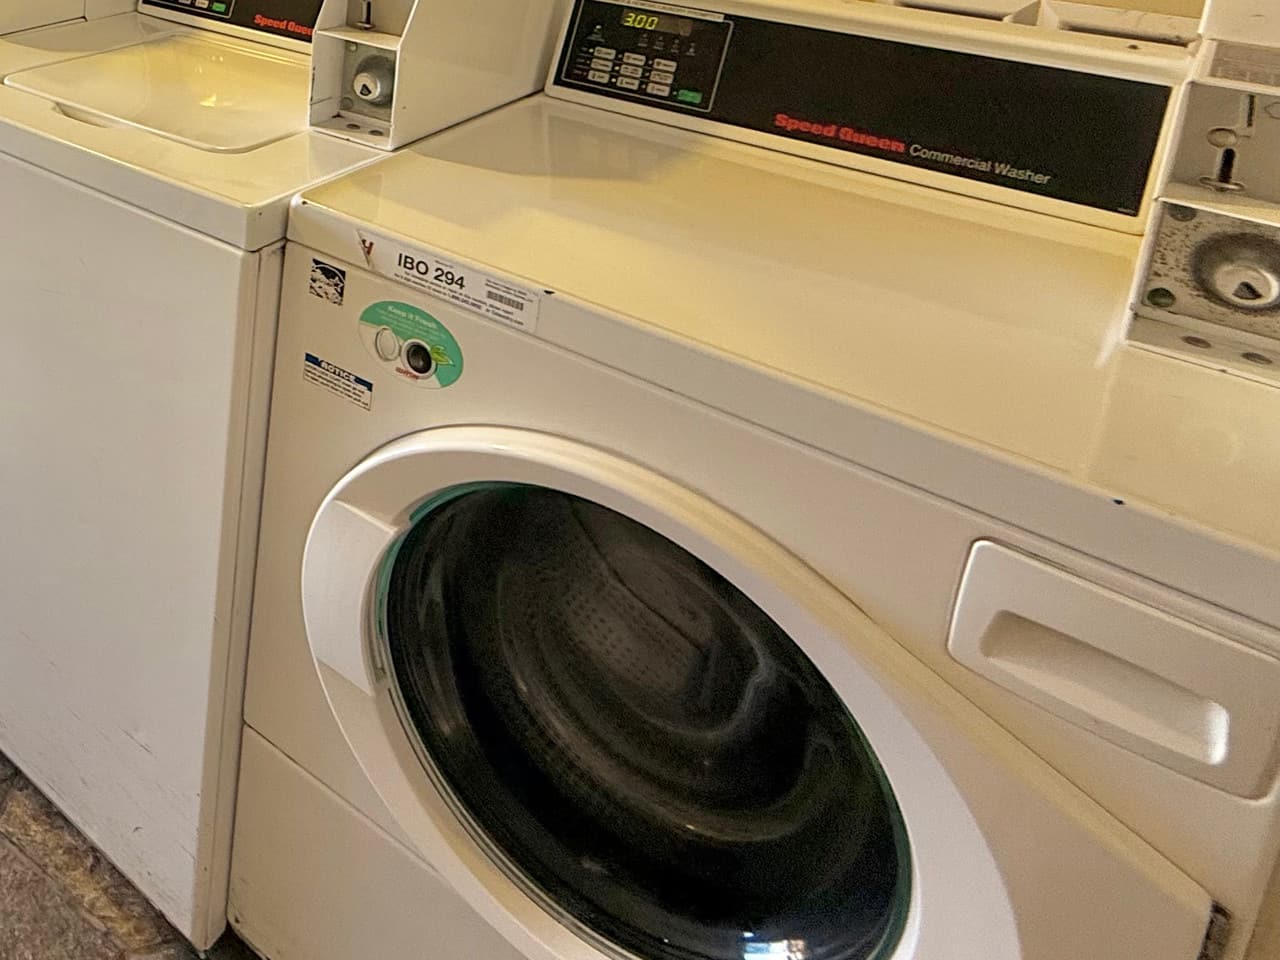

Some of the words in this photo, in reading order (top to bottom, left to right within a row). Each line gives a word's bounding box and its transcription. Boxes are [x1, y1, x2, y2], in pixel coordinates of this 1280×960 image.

[254, 14, 287, 30] Speed
[775, 113, 836, 137] Speed
[839, 126, 906, 153] Queen
[909, 144, 992, 173] Commercial
[994, 161, 1051, 185] Washer
[397, 252, 429, 276] IBO
[433, 267, 466, 290] 294
[320, 360, 357, 383] NOTICE
